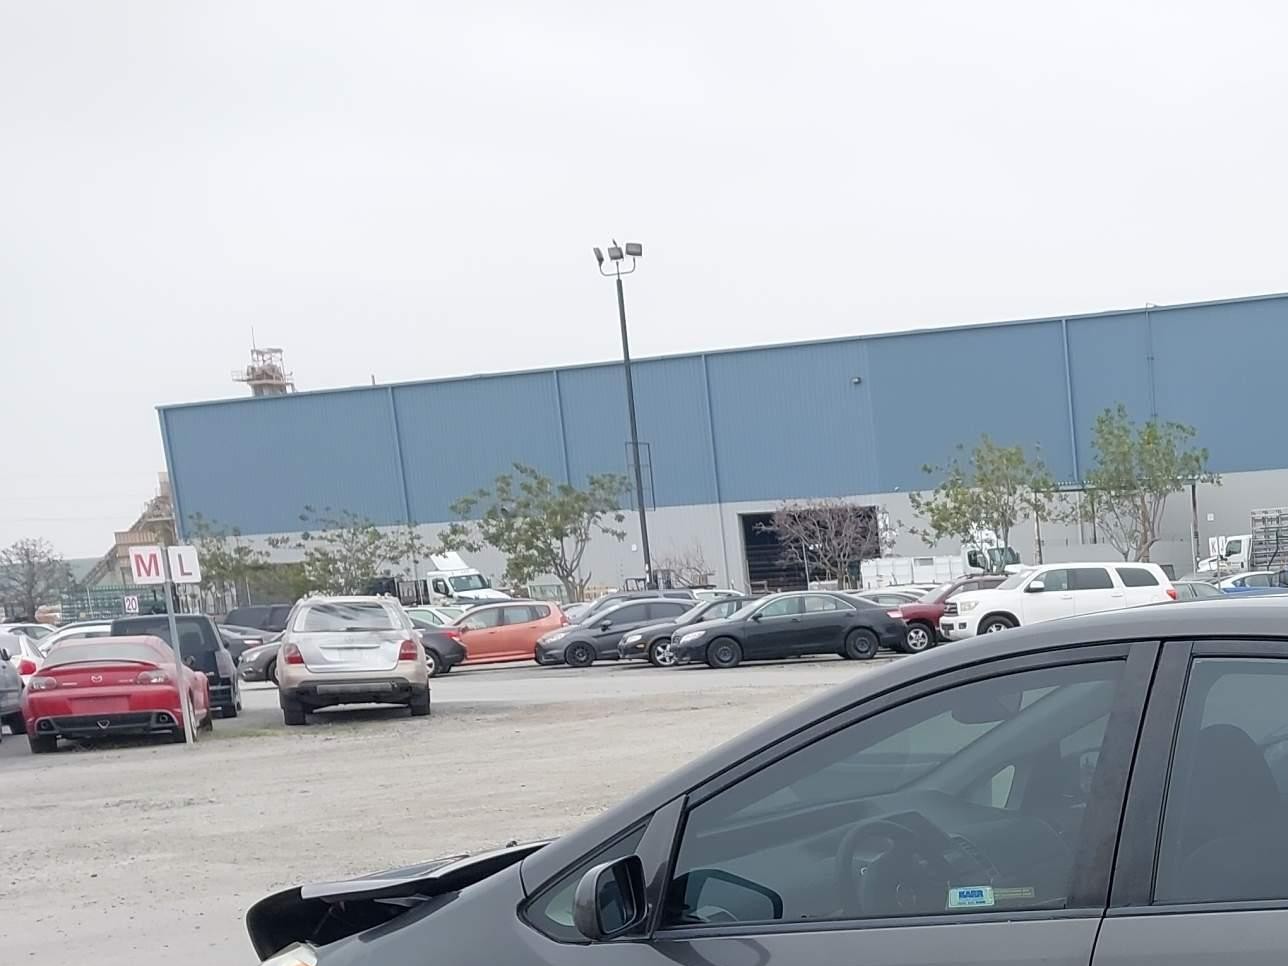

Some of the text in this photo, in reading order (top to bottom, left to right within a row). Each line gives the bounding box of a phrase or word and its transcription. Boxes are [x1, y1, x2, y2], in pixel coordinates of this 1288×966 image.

[134, 553, 160, 577] M
[178, 553, 193, 576] L
[126, 597, 138, 611] 20
